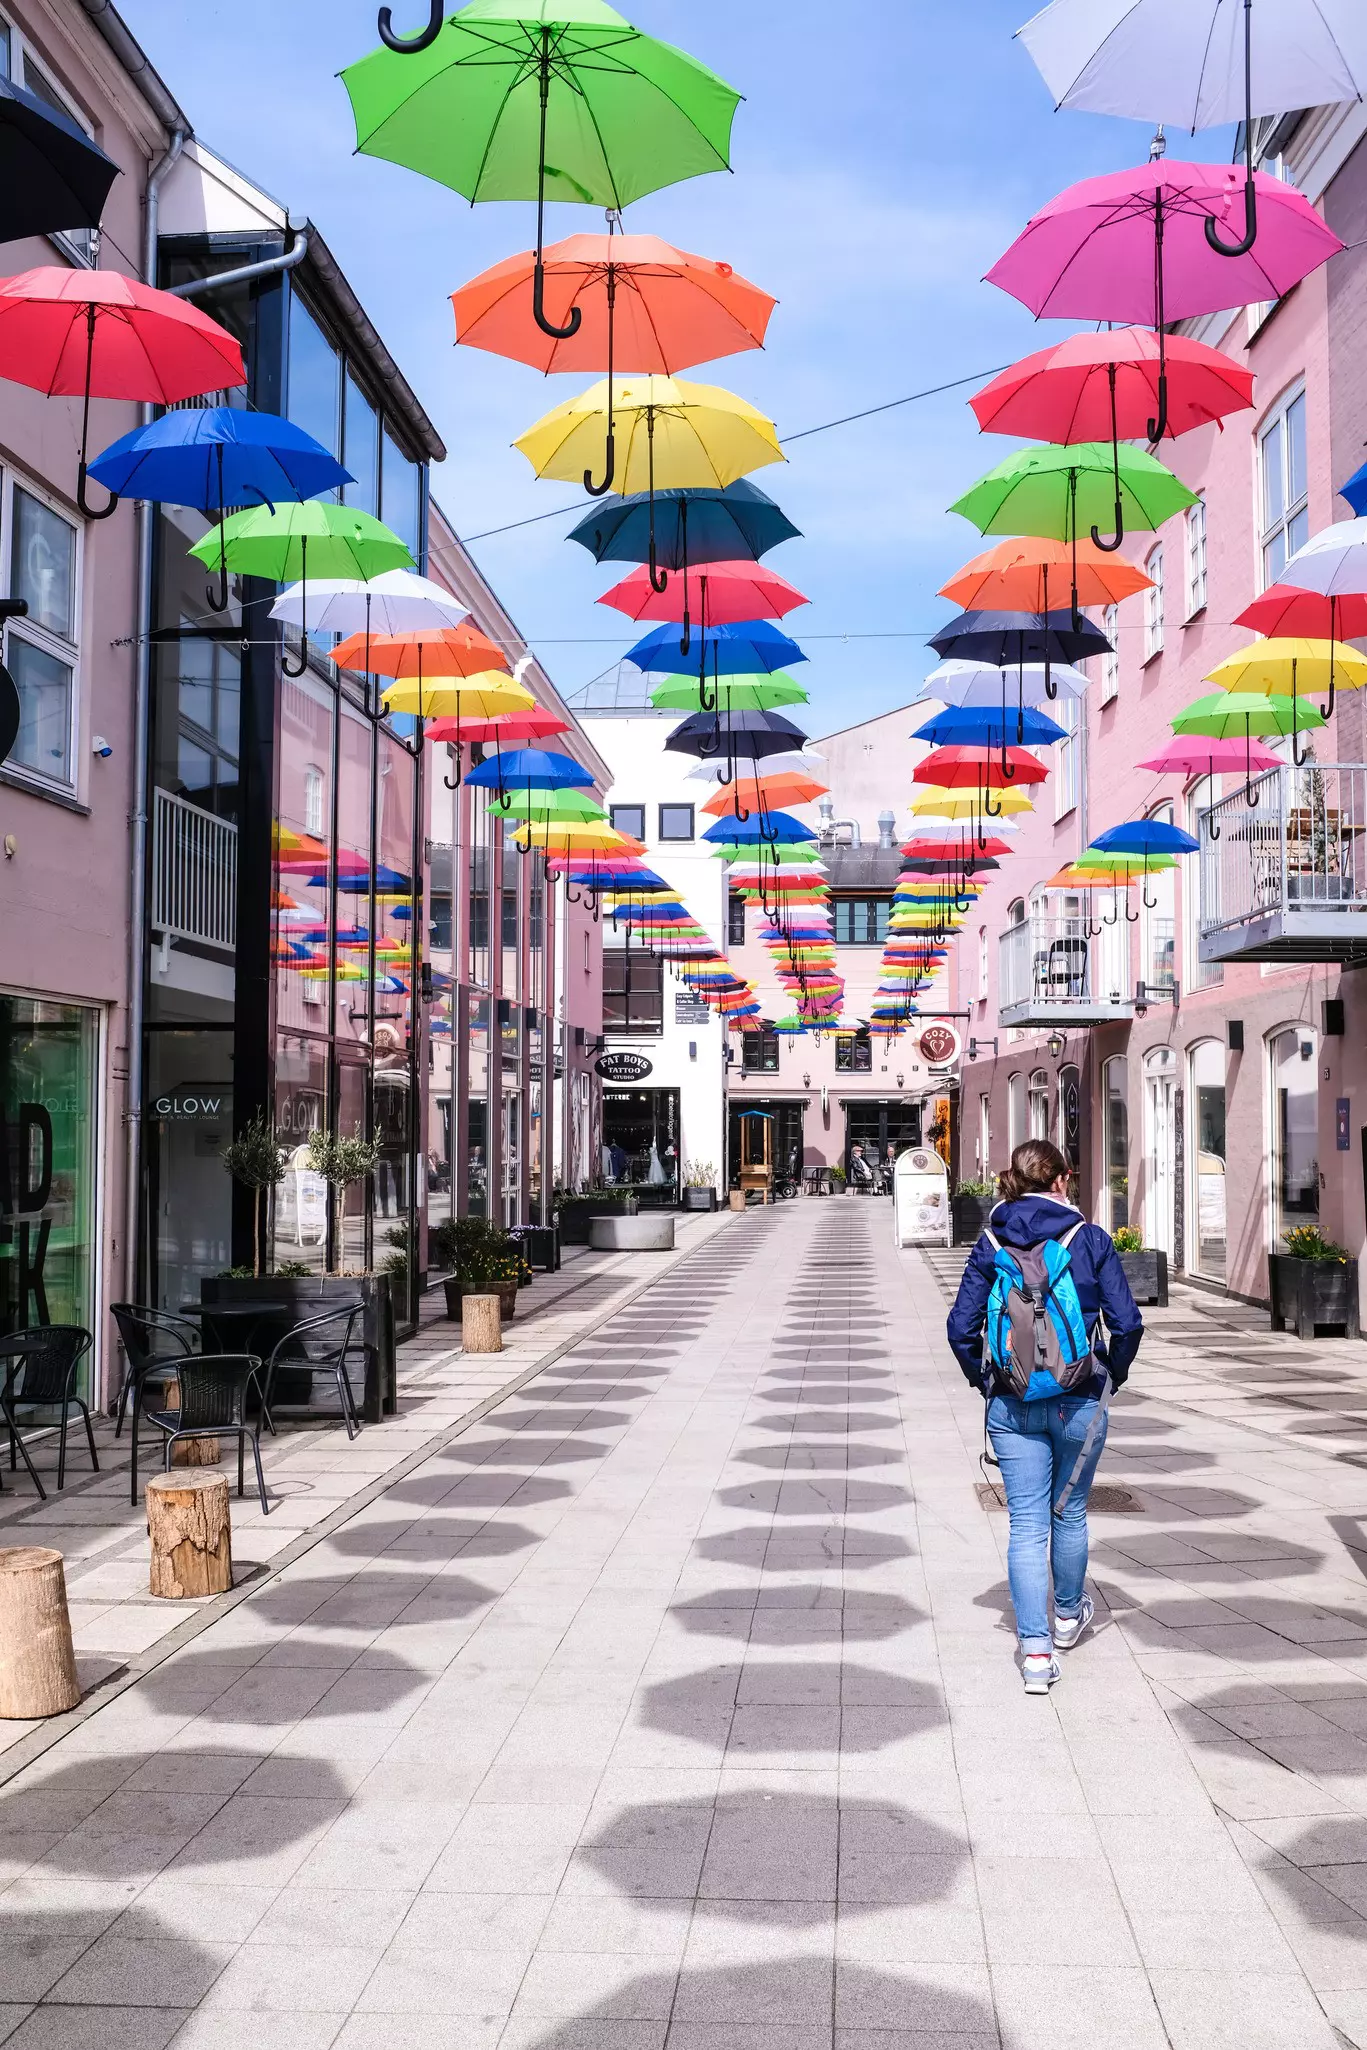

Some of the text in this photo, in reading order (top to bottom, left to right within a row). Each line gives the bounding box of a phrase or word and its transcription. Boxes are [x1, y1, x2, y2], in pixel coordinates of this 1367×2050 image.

[925, 1030, 952, 1040] COZY
[600, 1055, 649, 1069] FAT BOYS
[156, 1098, 221, 1114] GLOW
